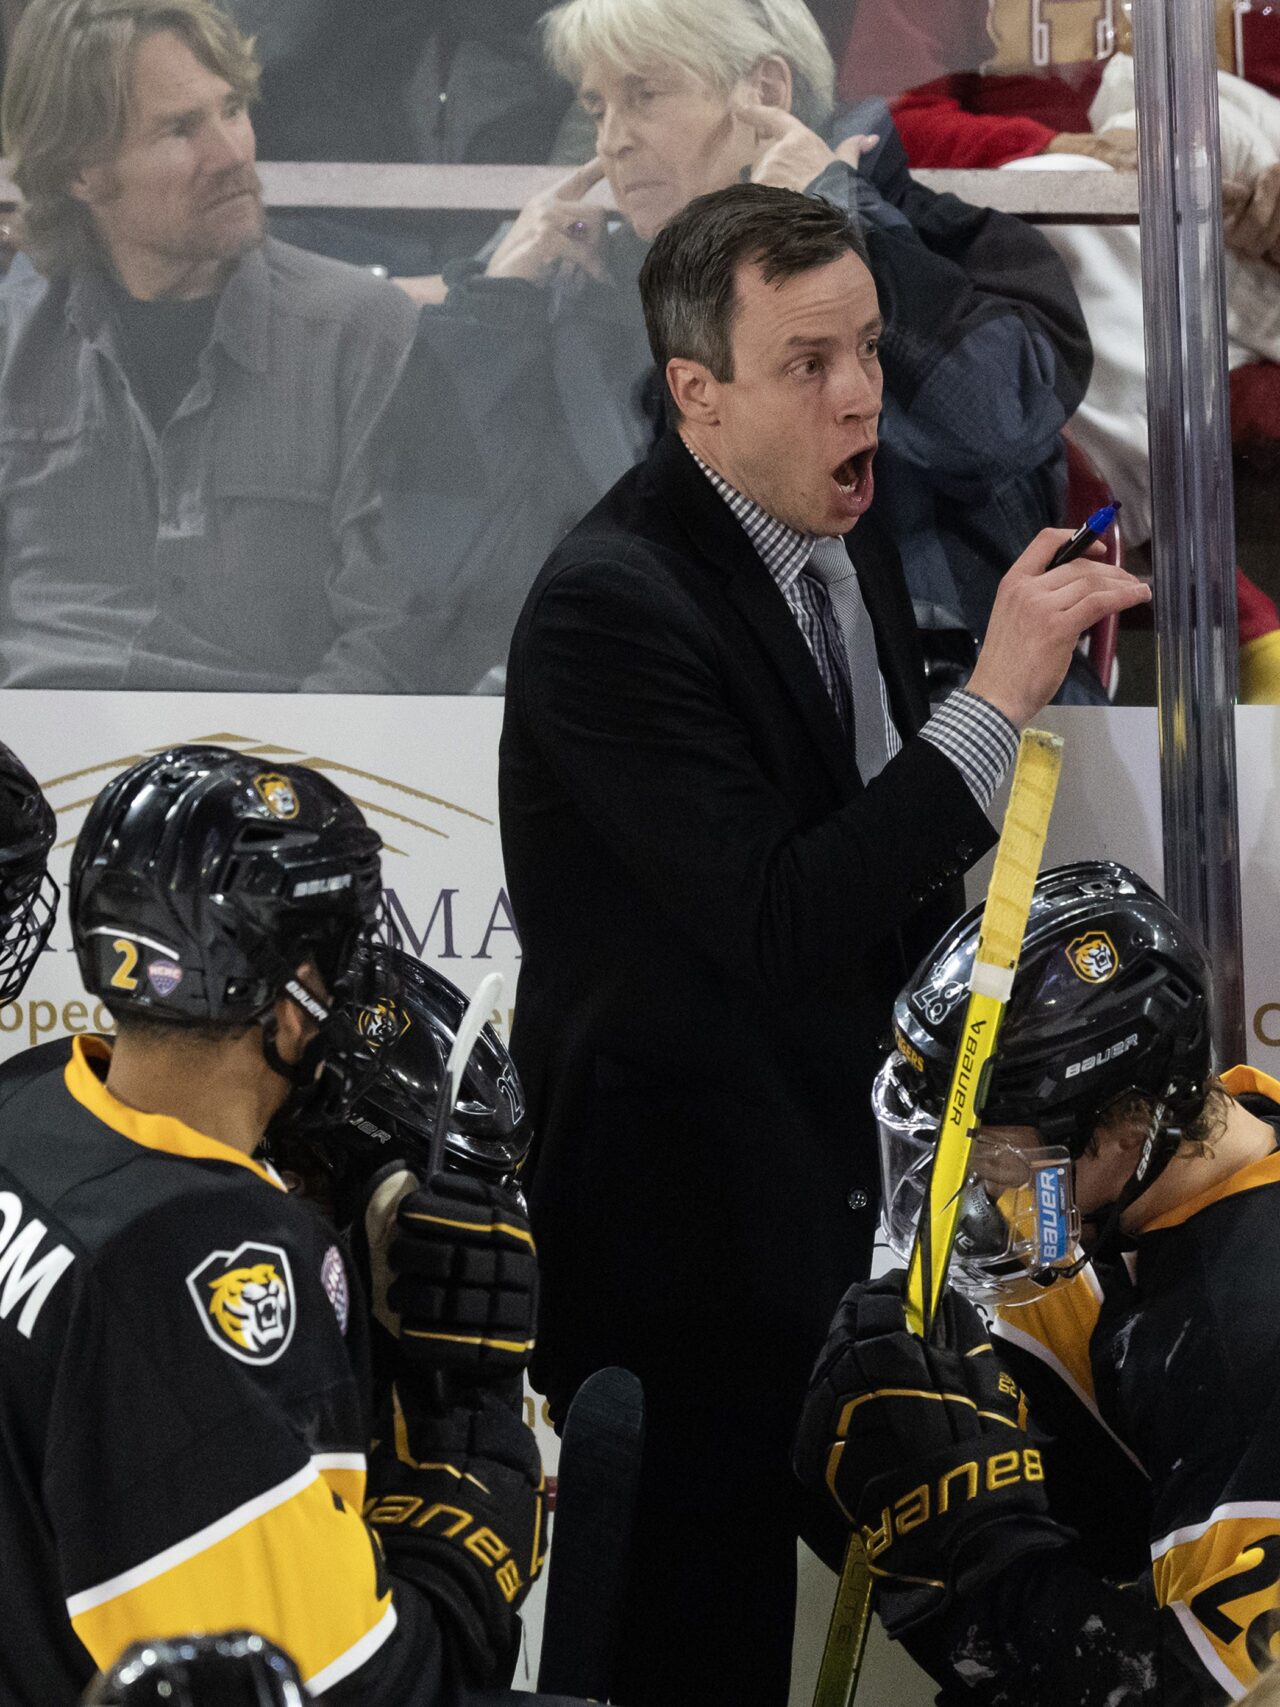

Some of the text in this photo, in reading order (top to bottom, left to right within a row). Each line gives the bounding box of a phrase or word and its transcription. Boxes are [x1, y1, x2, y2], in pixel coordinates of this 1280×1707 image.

[110, 938, 138, 990] 2
[949, 1038, 979, 1127] BAUER
[1065, 1032, 1139, 1079] BAUER
[1039, 1171, 1059, 1260] BAUER
[363, 1495, 523, 1603] BAUE
[866, 1450, 1046, 1559] BAUER
